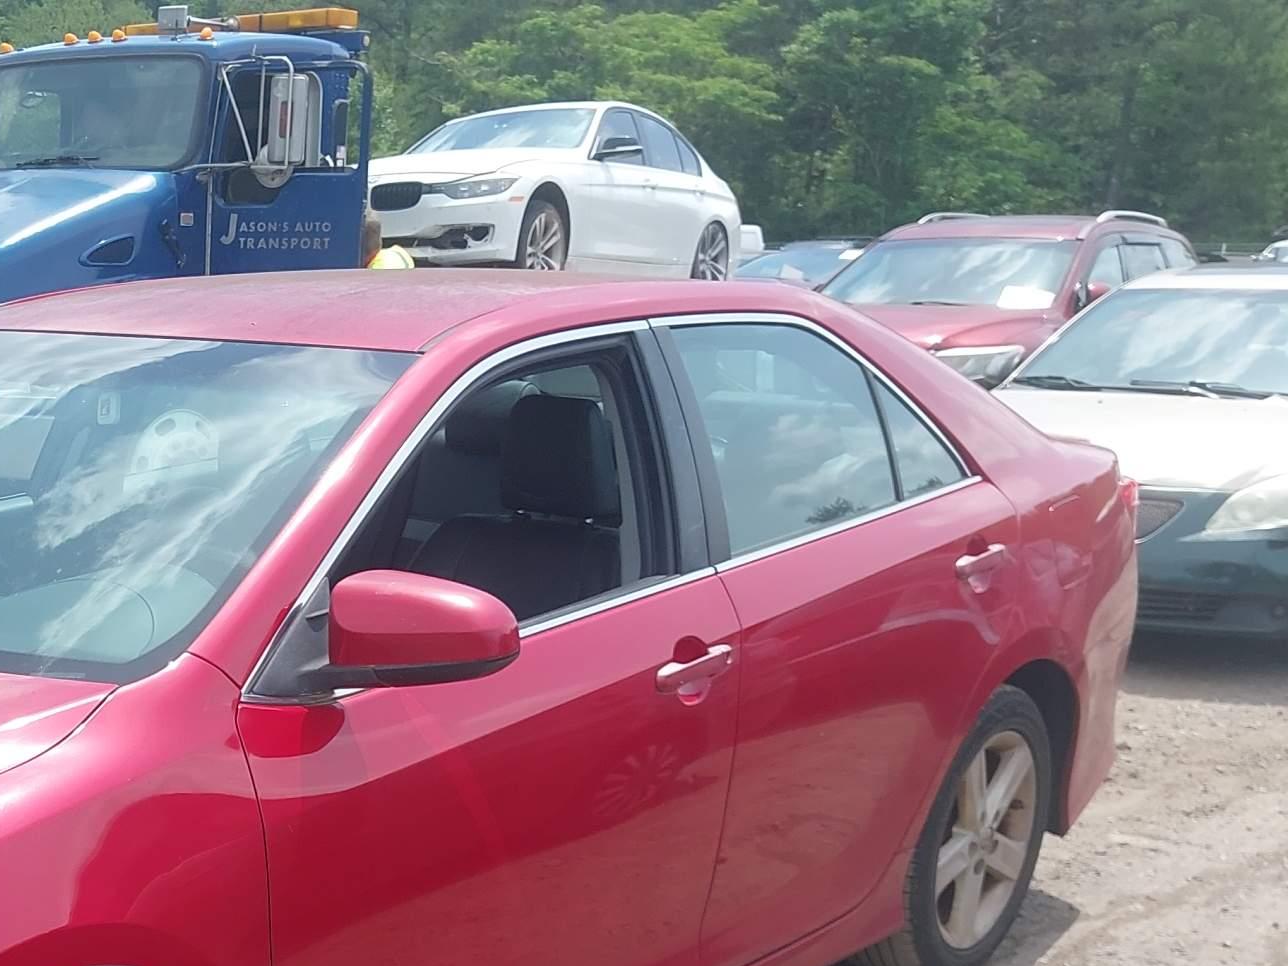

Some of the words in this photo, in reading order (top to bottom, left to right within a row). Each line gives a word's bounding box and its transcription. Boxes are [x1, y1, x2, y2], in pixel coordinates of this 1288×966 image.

[219, 213, 289, 245] JASON'S
[294, 222, 332, 232] AUTO
[239, 237, 331, 249] TRANSPORT
